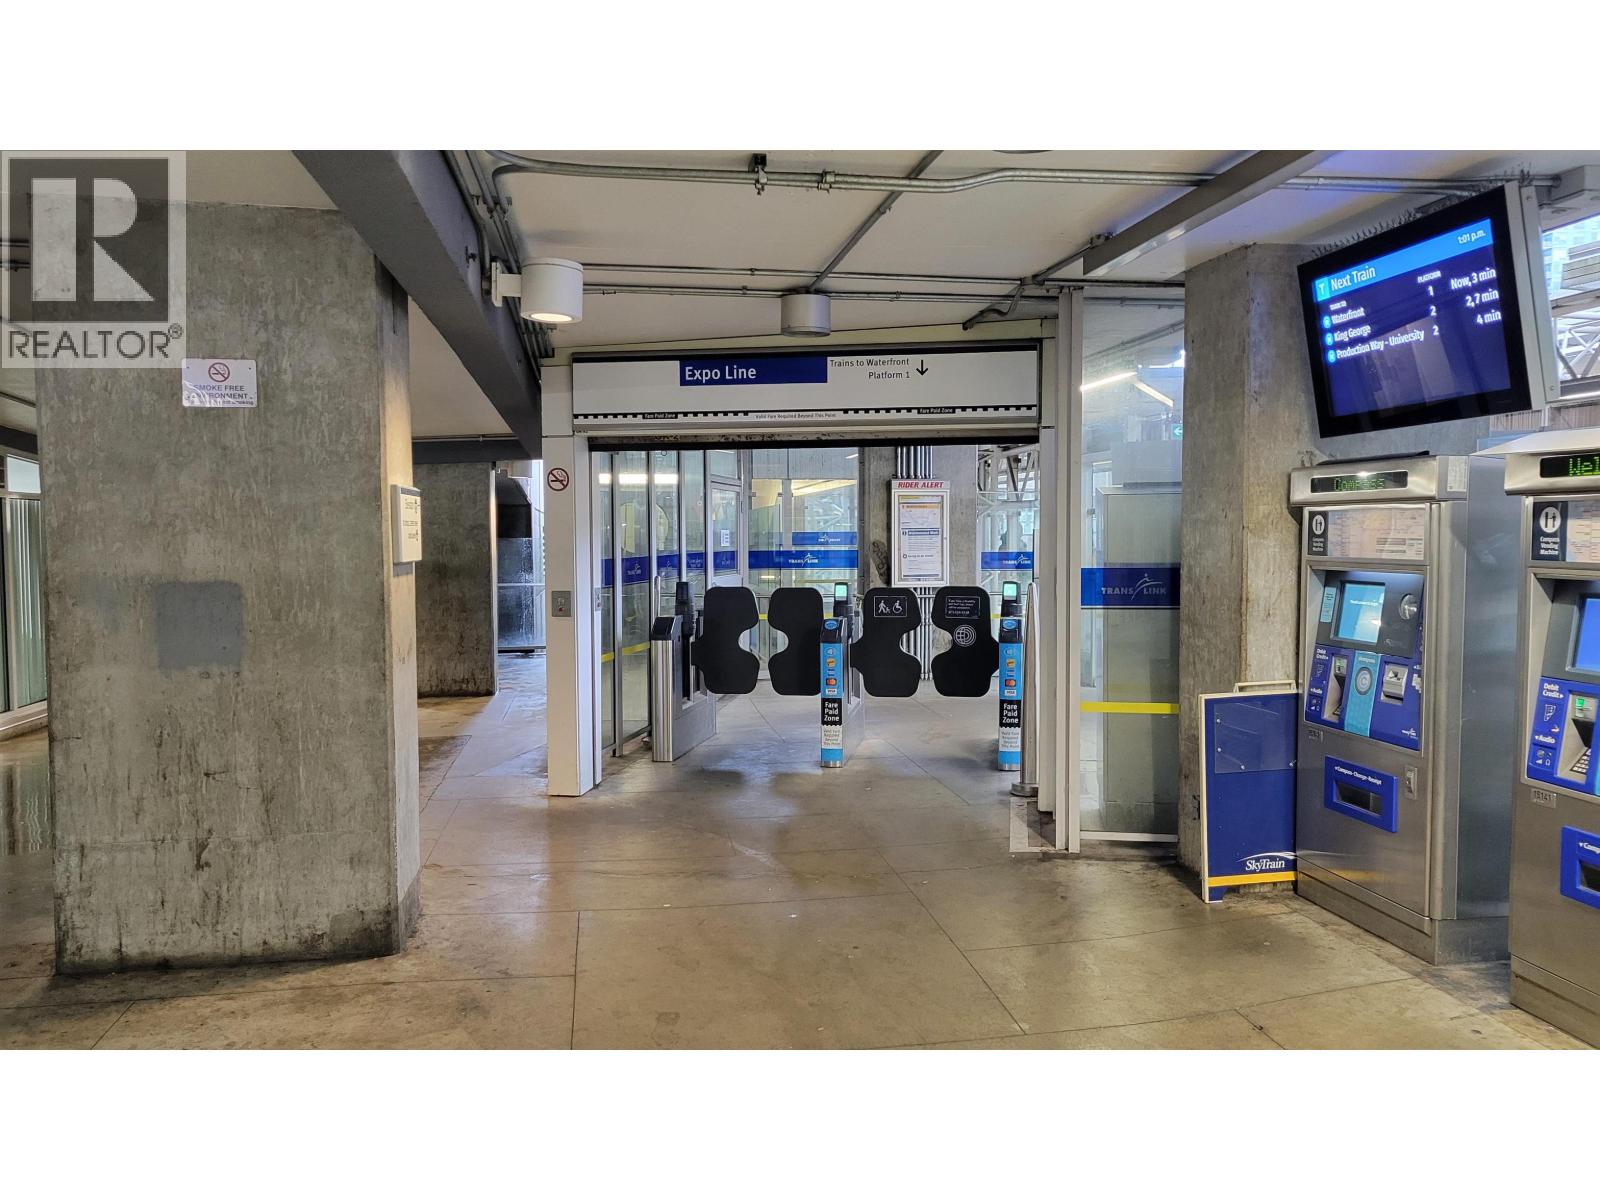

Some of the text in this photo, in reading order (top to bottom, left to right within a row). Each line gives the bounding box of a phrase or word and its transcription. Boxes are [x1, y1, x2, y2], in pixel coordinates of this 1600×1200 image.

[1458, 230, 1486, 244] 1:01 p.m.
[1331, 275, 1352, 291] Next
[1352, 266, 1376, 283] Train
[1451, 267, 1497, 290] Now, 3 min
[1428, 286, 1434, 296] 1
[1482, 288, 1499, 303] min
[1331, 307, 1365, 324] Waterfront
[1430, 306, 1437, 317] 2
[1476, 309, 1502, 325] 4 min
[1334, 325, 1372, 342] King George
[1432, 325, 1440, 336] 2
[1337, 344, 1370, 359] Production
[1370, 340, 1385, 351] Way
[1389, 329, 1425, 346] University
[830, 358, 910, 368] Trains to Waterfront
[685, 365, 757, 383] Expo Line
[868, 371, 910, 380] Platform 1
[194, 384, 245, 392] SMOKE FREE
[898, 481, 944, 489] RIDER ALERT
[1544, 683, 1559, 691] Debit
[1543, 690, 1560, 698] Credit
[1538, 735, 1555, 743] Audio
[1245, 858, 1285, 873] SkyTrain
